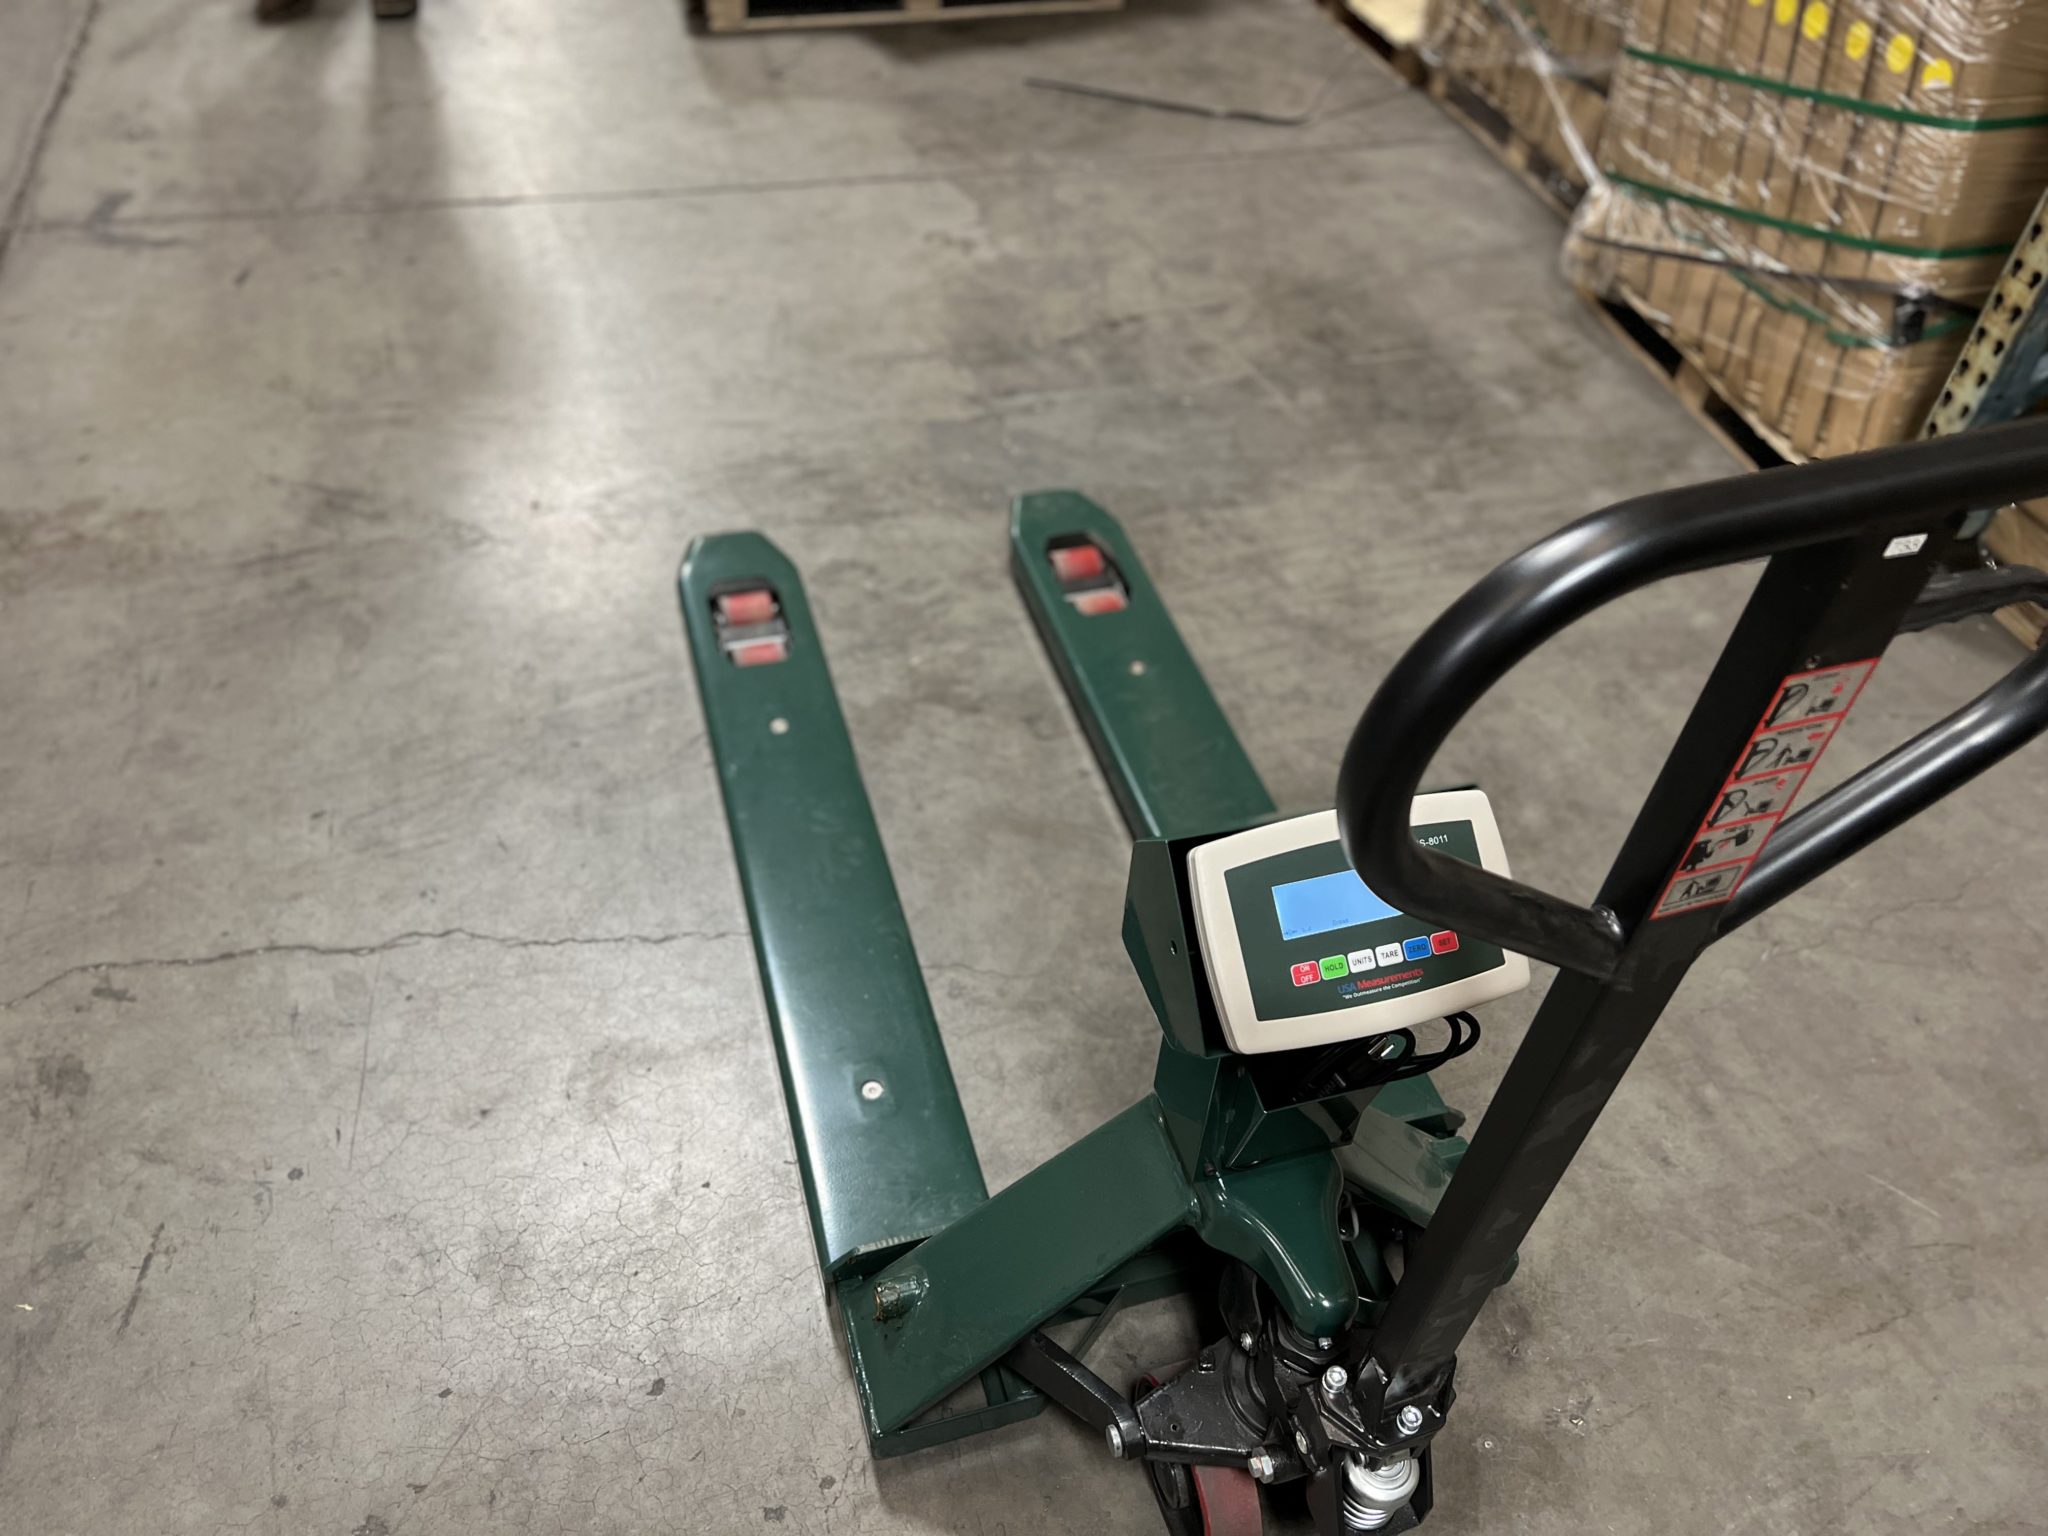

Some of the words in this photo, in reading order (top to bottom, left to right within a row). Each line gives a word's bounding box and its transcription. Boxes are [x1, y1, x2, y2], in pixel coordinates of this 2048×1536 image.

[1416, 834, 1449, 847] S-8011
[1407, 943, 1427, 953] ZERO
[1380, 950, 1399, 959] TARE
[1351, 956, 1373, 966] UNITS
[1300, 964, 1311, 973] ON
[1324, 962, 1344, 972] HOLD
[1300, 974, 1314, 983] OFF
[1337, 982, 1358, 995] USA
[1356, 968, 1424, 991] Measurements
